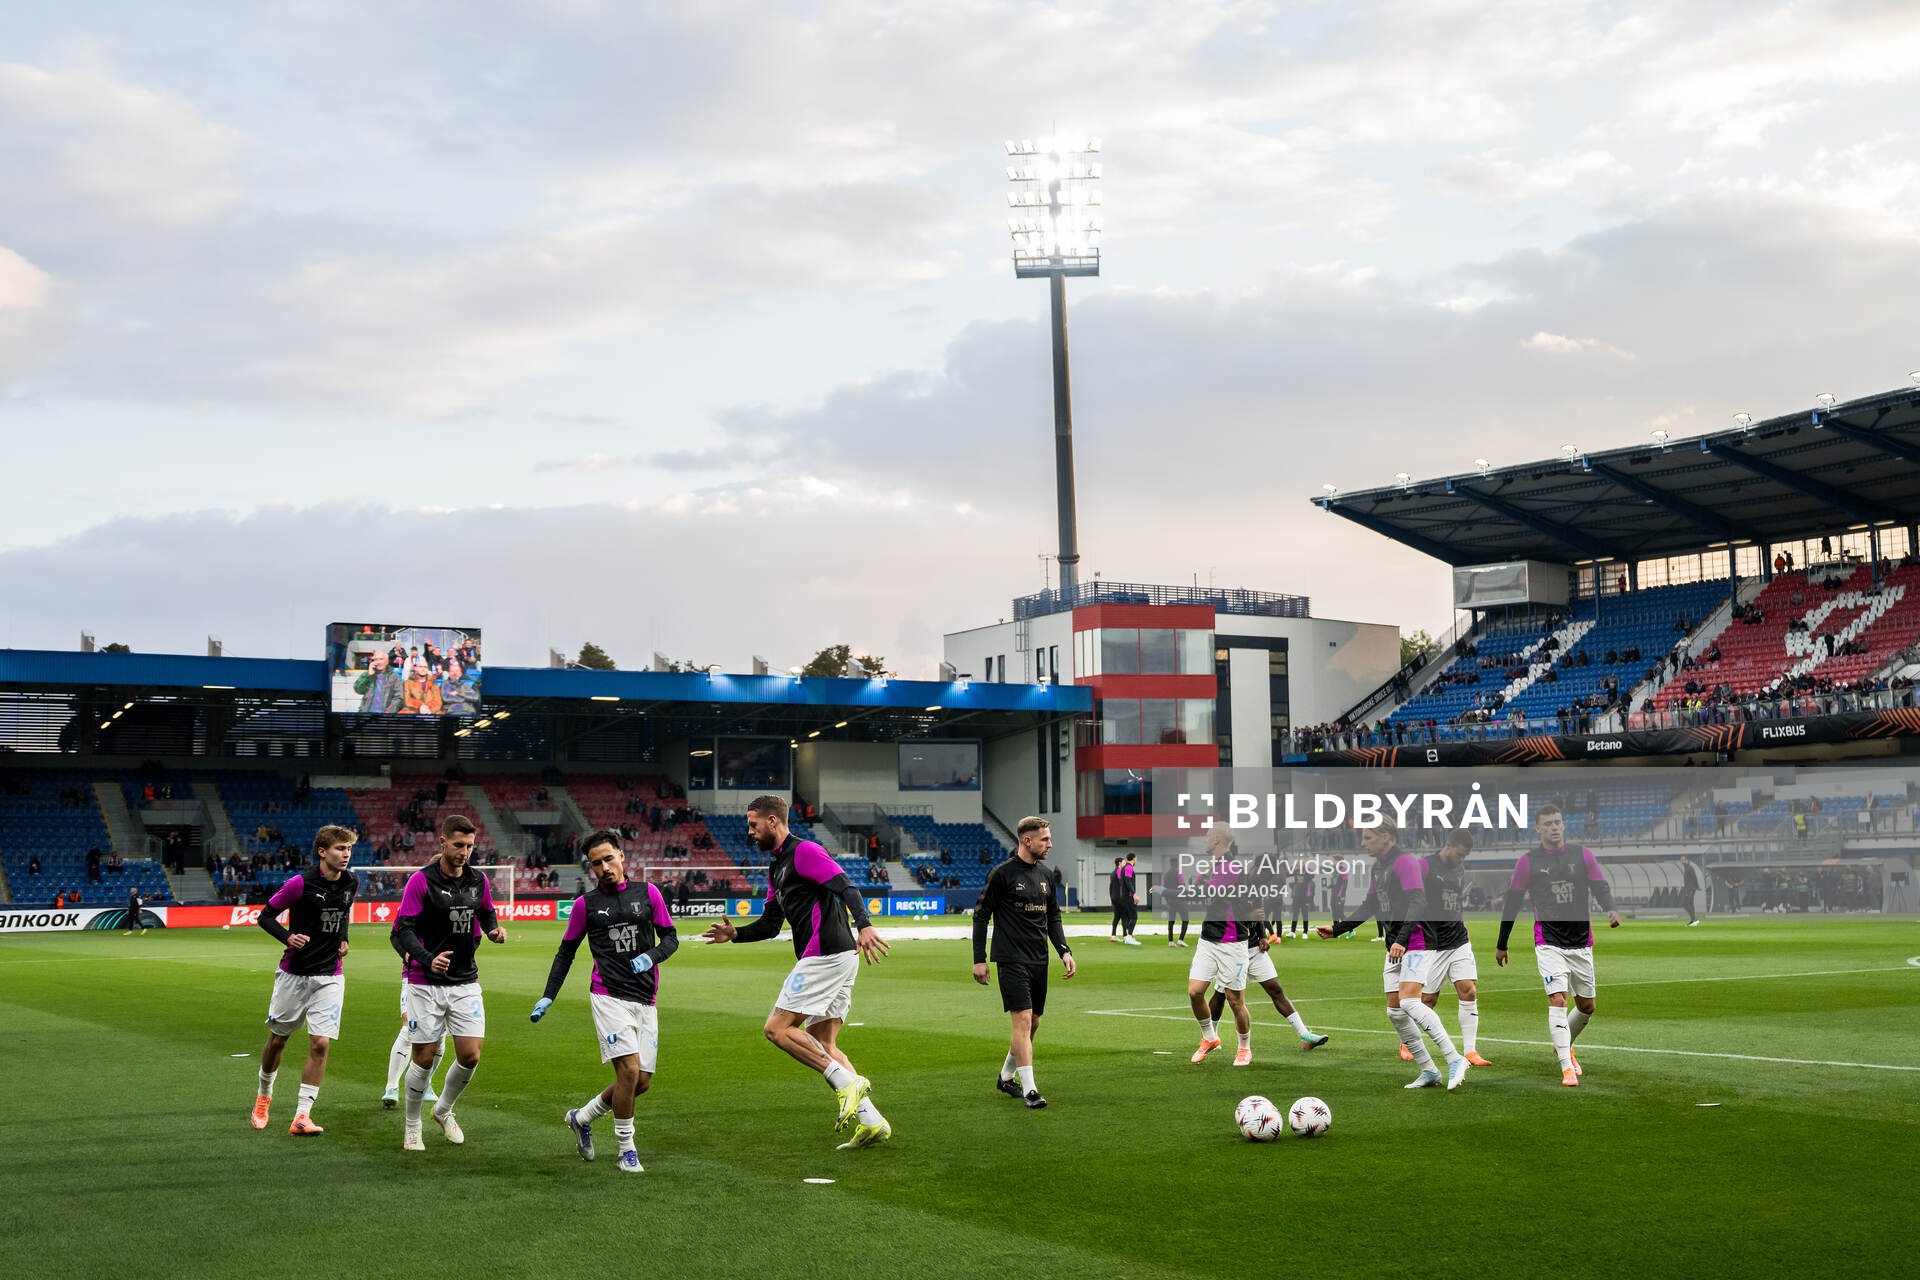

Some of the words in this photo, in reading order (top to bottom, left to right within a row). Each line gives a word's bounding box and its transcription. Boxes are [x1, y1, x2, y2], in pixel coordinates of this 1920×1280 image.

[1587, 740, 1622, 751] Betano
[896, 900, 938, 911] RECYCLE
[1406, 953, 1425, 970] 17
[1235, 962, 1244, 979] 7
